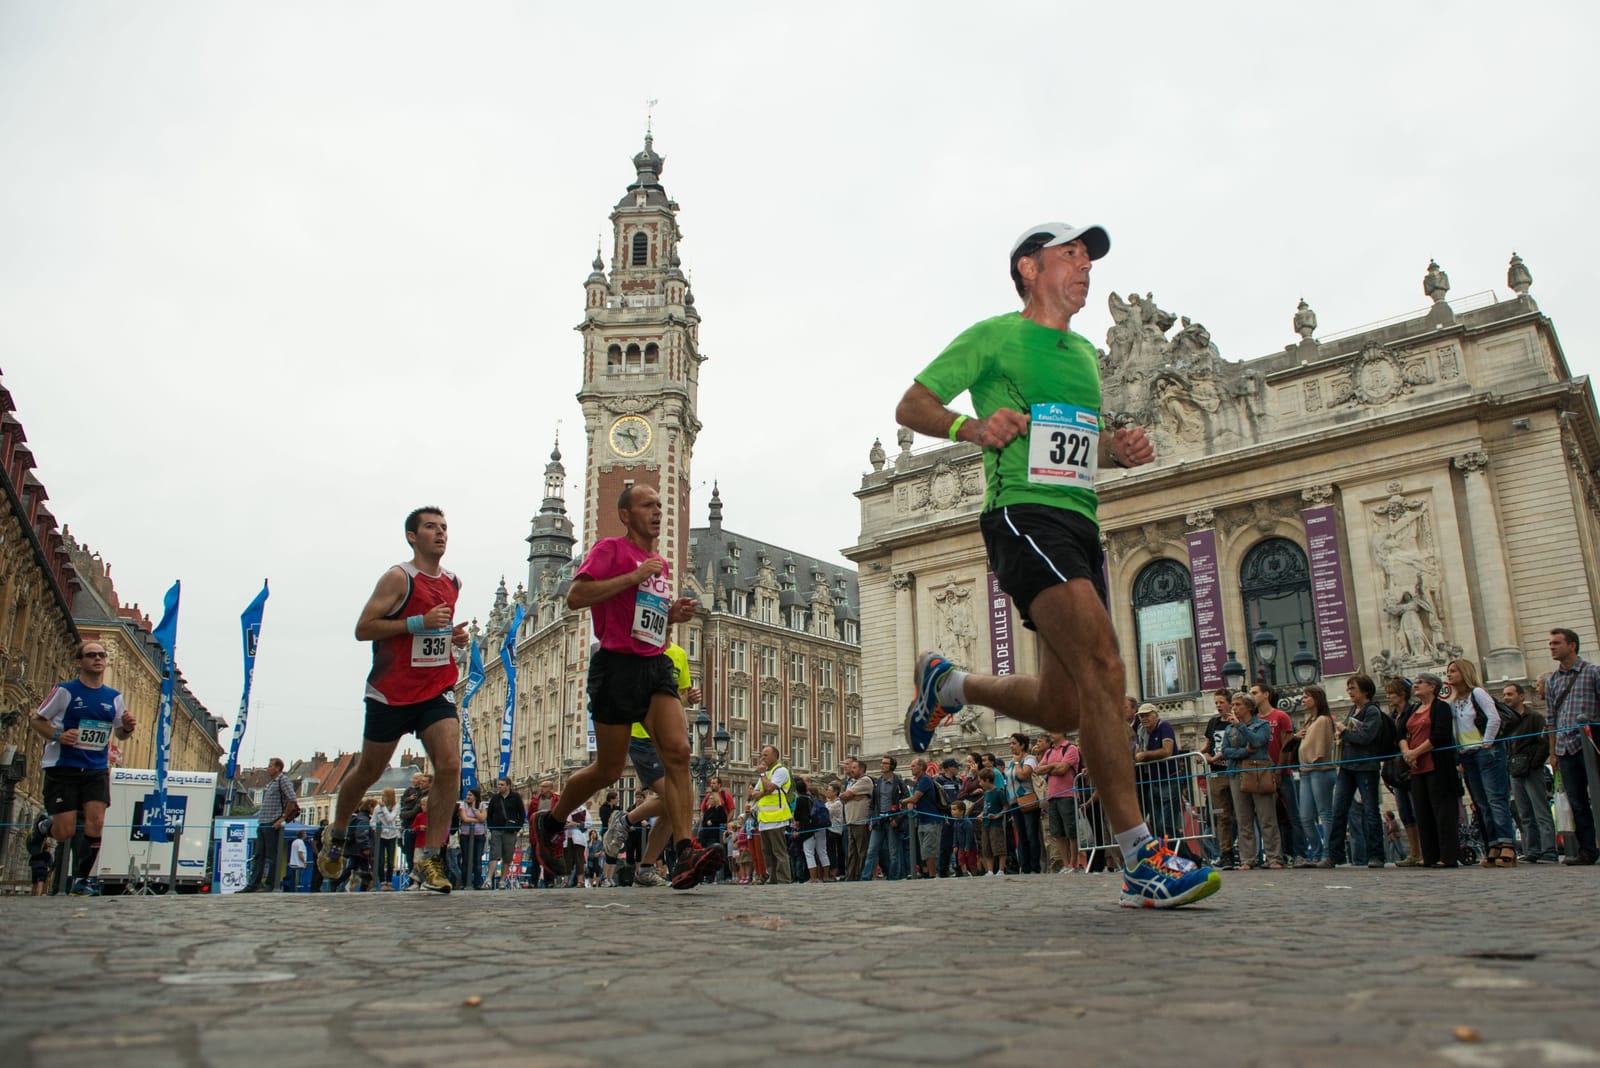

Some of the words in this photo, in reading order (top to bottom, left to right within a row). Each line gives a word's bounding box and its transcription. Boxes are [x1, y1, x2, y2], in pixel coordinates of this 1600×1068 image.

[1049, 431, 1090, 468] 322
[640, 609, 665, 635] 5749
[994, 610, 1008, 641] LILLE
[422, 637, 446, 656] 335
[996, 642, 1009, 658] DE
[80, 729, 106, 744] 5370
